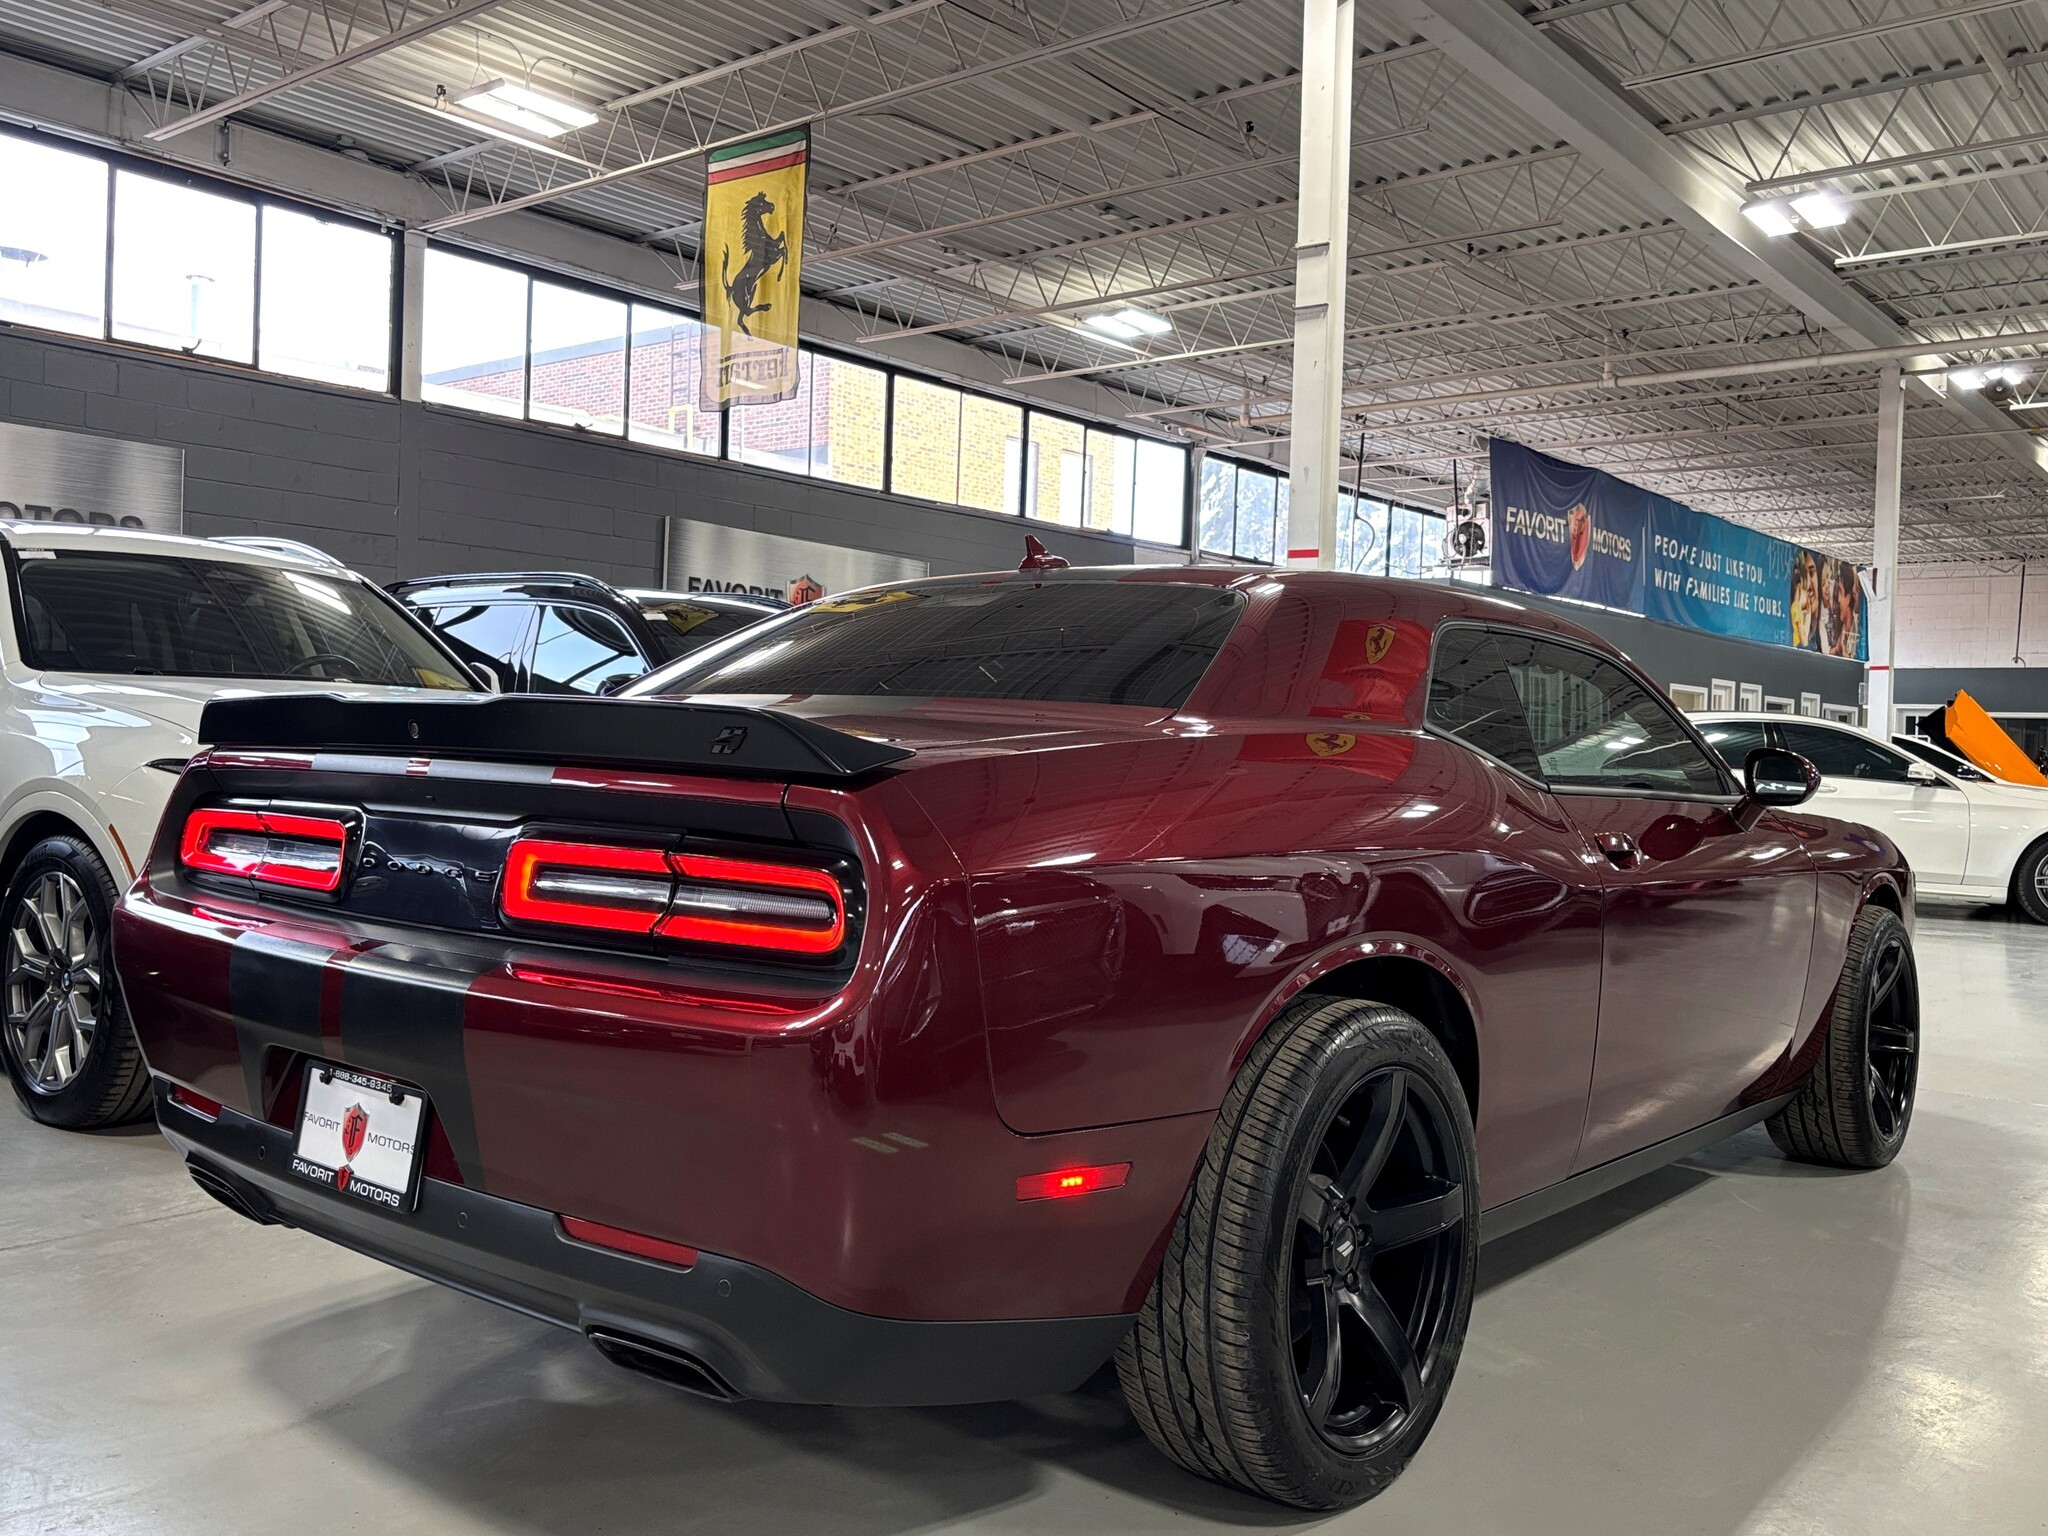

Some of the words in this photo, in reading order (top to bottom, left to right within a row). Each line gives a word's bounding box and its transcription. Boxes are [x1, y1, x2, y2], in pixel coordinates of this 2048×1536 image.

[1505, 506, 1566, 543] FAVORIT
[1592, 527, 1632, 562] MOTORS
[1654, 534, 1697, 566] PEOE
[1699, 550, 1722, 573] JUST
[1725, 556, 1744, 578] LIKE
[1654, 567, 1681, 593] WITH
[1685, 577, 1731, 605] FAMILIES
[1733, 589, 1750, 610] LIKE
[328, 1068, 393, 1093] 1-888-345-9345
[303, 1111, 341, 1133] FAVORIT
[367, 1132, 417, 1155] MOTORS
[292, 1159, 335, 1184] FAVORIT
[349, 1180, 400, 1207] MOTORS
